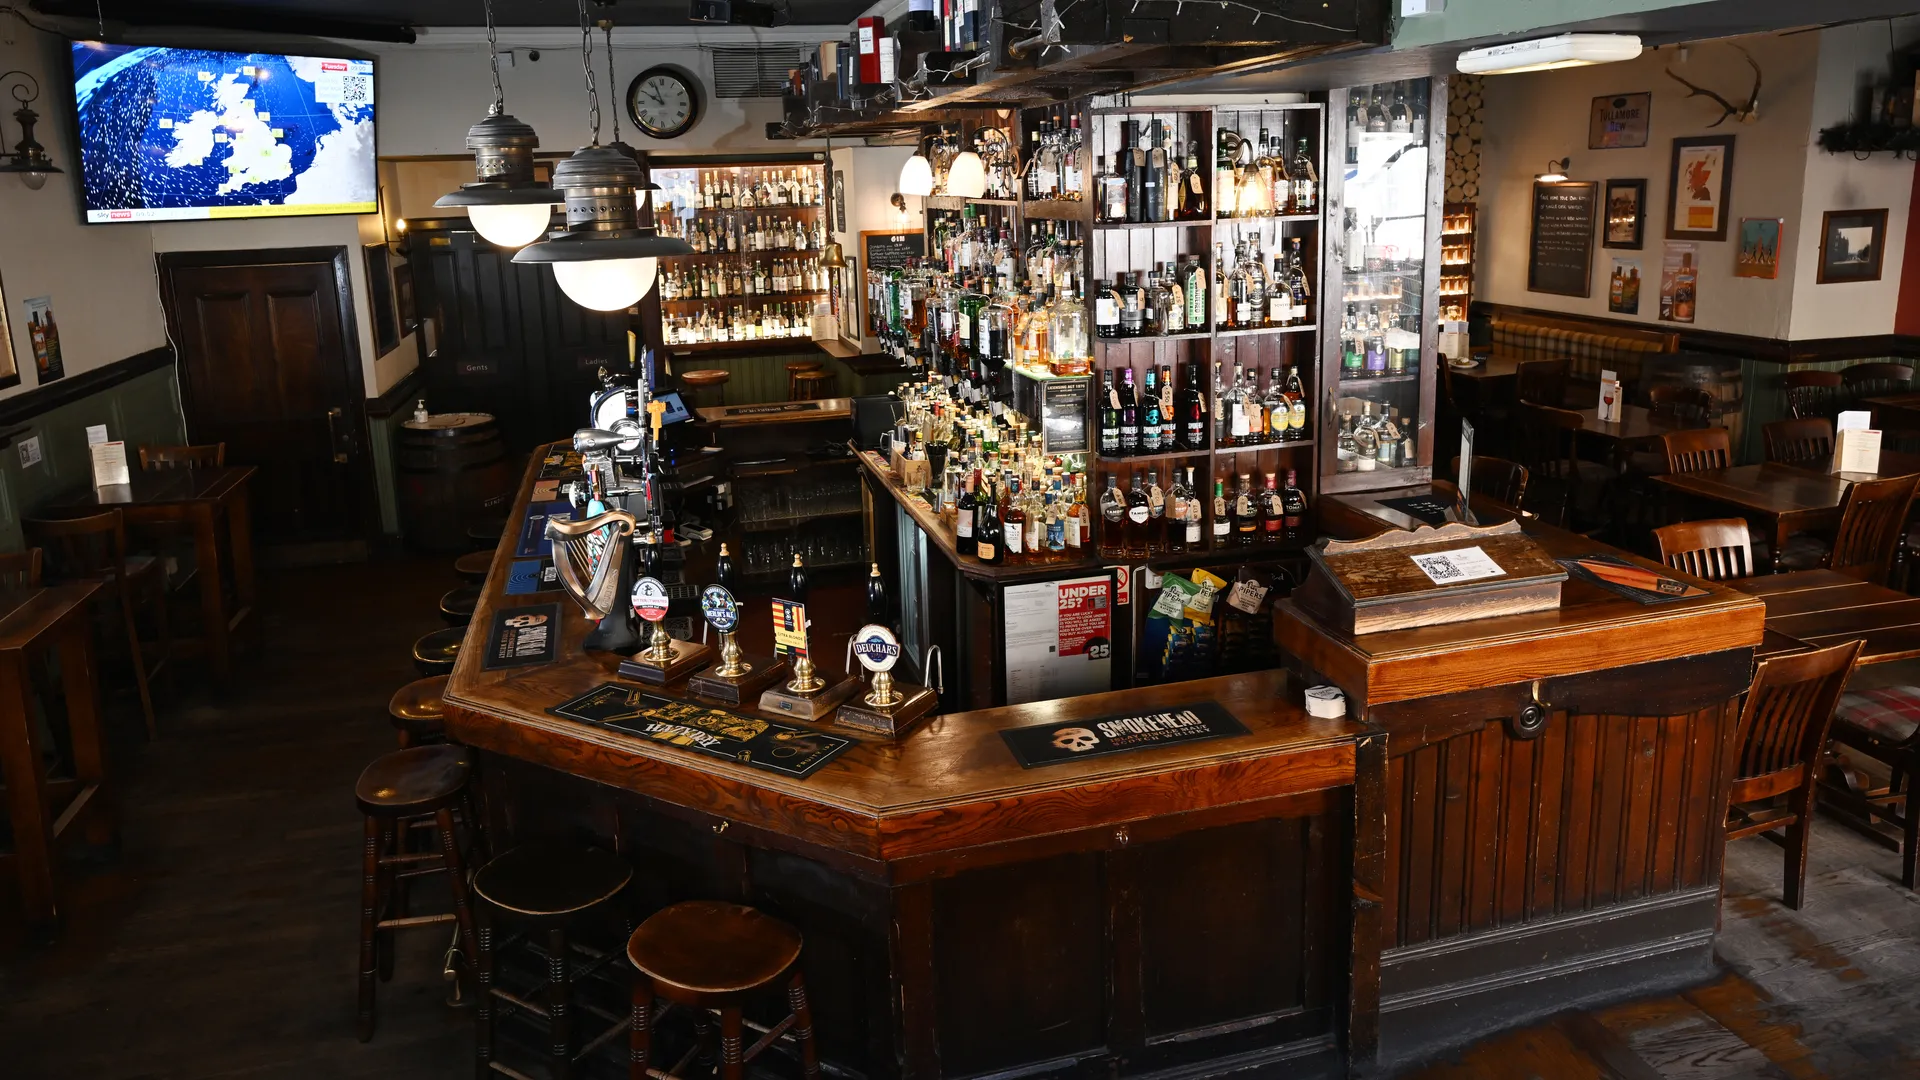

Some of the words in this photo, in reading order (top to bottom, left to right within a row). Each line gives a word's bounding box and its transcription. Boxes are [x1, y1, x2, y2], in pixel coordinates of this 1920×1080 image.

[1600, 109, 1640, 121] TULLAMORE
[111, 211, 131, 219] news
[466, 363, 489, 372] Gents
[585, 357, 609, 366] Ladies
[1060, 585, 1107, 599] UNDER
[1238, 585, 1266, 600] PIPERS
[1059, 597, 1083, 610] 25?
[856, 643, 897, 656] DEUCHARS
[1090, 644, 1110, 658] 25
[1096, 711, 1203, 738] SMOKEHEAD
